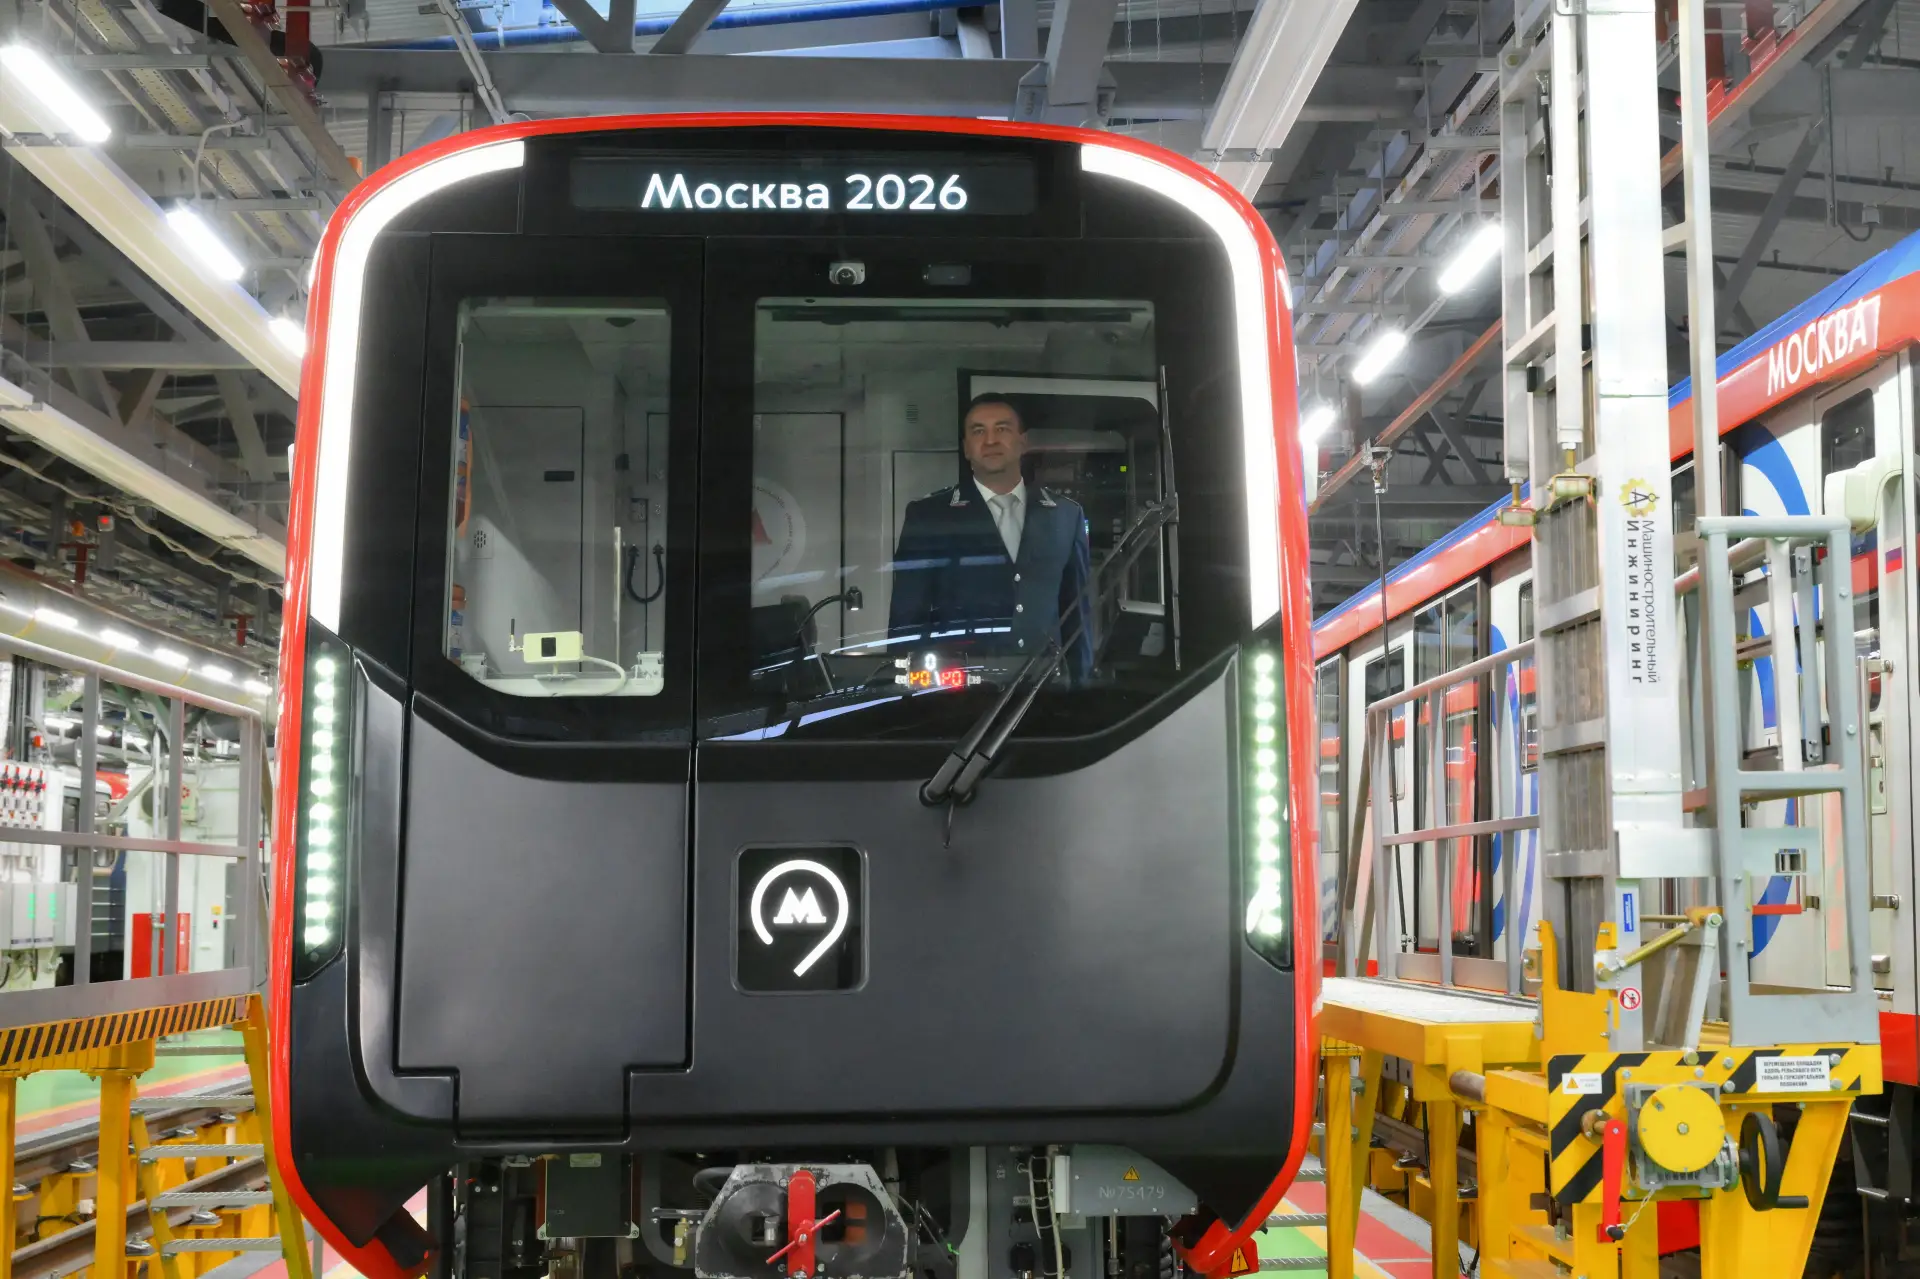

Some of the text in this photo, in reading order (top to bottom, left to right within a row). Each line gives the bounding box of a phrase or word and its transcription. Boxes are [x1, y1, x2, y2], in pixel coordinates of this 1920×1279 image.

[641, 173, 968, 210] Москва 2026
[1768, 298, 1868, 397] МОСКВА
[1642, 520, 1661, 683] Машиностроительный
